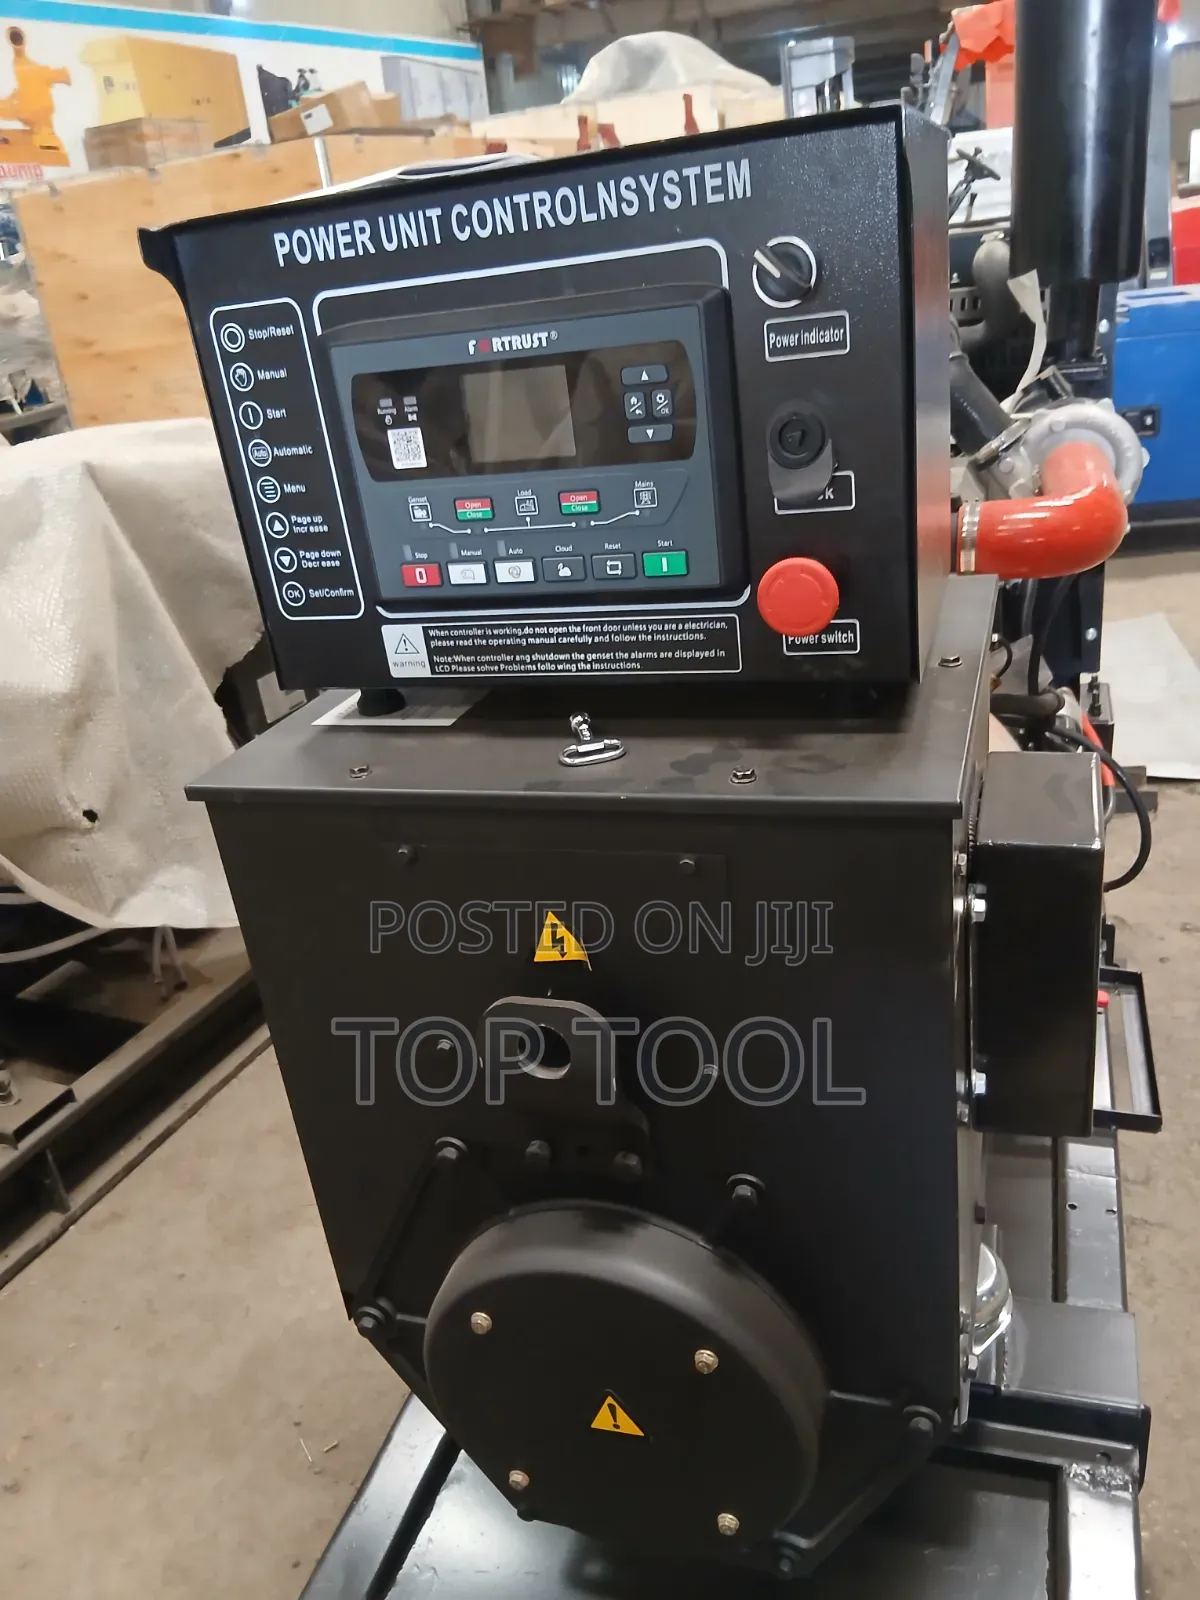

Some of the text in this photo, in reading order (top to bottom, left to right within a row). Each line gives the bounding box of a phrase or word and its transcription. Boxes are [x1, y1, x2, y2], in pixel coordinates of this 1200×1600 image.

[274, 158, 753, 268] POWER UNIT CONTROLNSYSTEM
[248, 324, 294, 341] Stop/Reset
[769, 331, 799, 349] Power
[257, 368, 288, 381] Manual
[266, 408, 287, 420] Start
[273, 444, 314, 457] Automatic
[283, 484, 306, 494] Menu
[634, 480, 654, 488] Mains
[570, 494, 588, 502] Open
[464, 501, 482, 510] Open
[570, 504, 588, 512] Close
[466, 510, 483, 518] Close
[291, 514, 323, 525] Page up
[508, 547, 524, 555] Auto
[555, 544, 573, 552] Cloud
[604, 542, 622, 550] Reset
[299, 550, 342, 560] Page down
[414, 552, 428, 560] Stop
[287, 589, 301, 599] OK
[308, 588, 355, 598] Set/Confirm
[428, 628, 450, 637] When
[450, 627, 485, 636] controller
[486, 627, 492, 636] is
[534, 626, 548, 634] not
[548, 626, 568, 636] open
[568, 624, 582, 633] the
[582, 624, 602, 632] front
[602, 624, 621, 632] door
[622, 622, 647, 632] unless
[648, 623, 662, 632] you
[684, 620, 728, 630] electrician,
[430, 632, 707, 648] please read the operating manual carefully and follow the instructions.
[821, 630, 854, 644] switch
[476, 654, 514, 662] controller
[516, 654, 530, 663] ang
[532, 652, 570, 660] shutdown
[572, 652, 584, 660] the
[586, 651, 614, 662] genset
[616, 651, 629, 660] the
[630, 650, 658, 659] alarms
[659, 651, 672, 659] are
[674, 649, 715, 660] displayed
[716, 649, 726, 657] in
[392, 659, 426, 669] warning
[435, 664, 450, 672] LCD
[451, 664, 476, 672] Please
[500, 662, 536, 672] Problems
[578, 661, 591, 670] the
